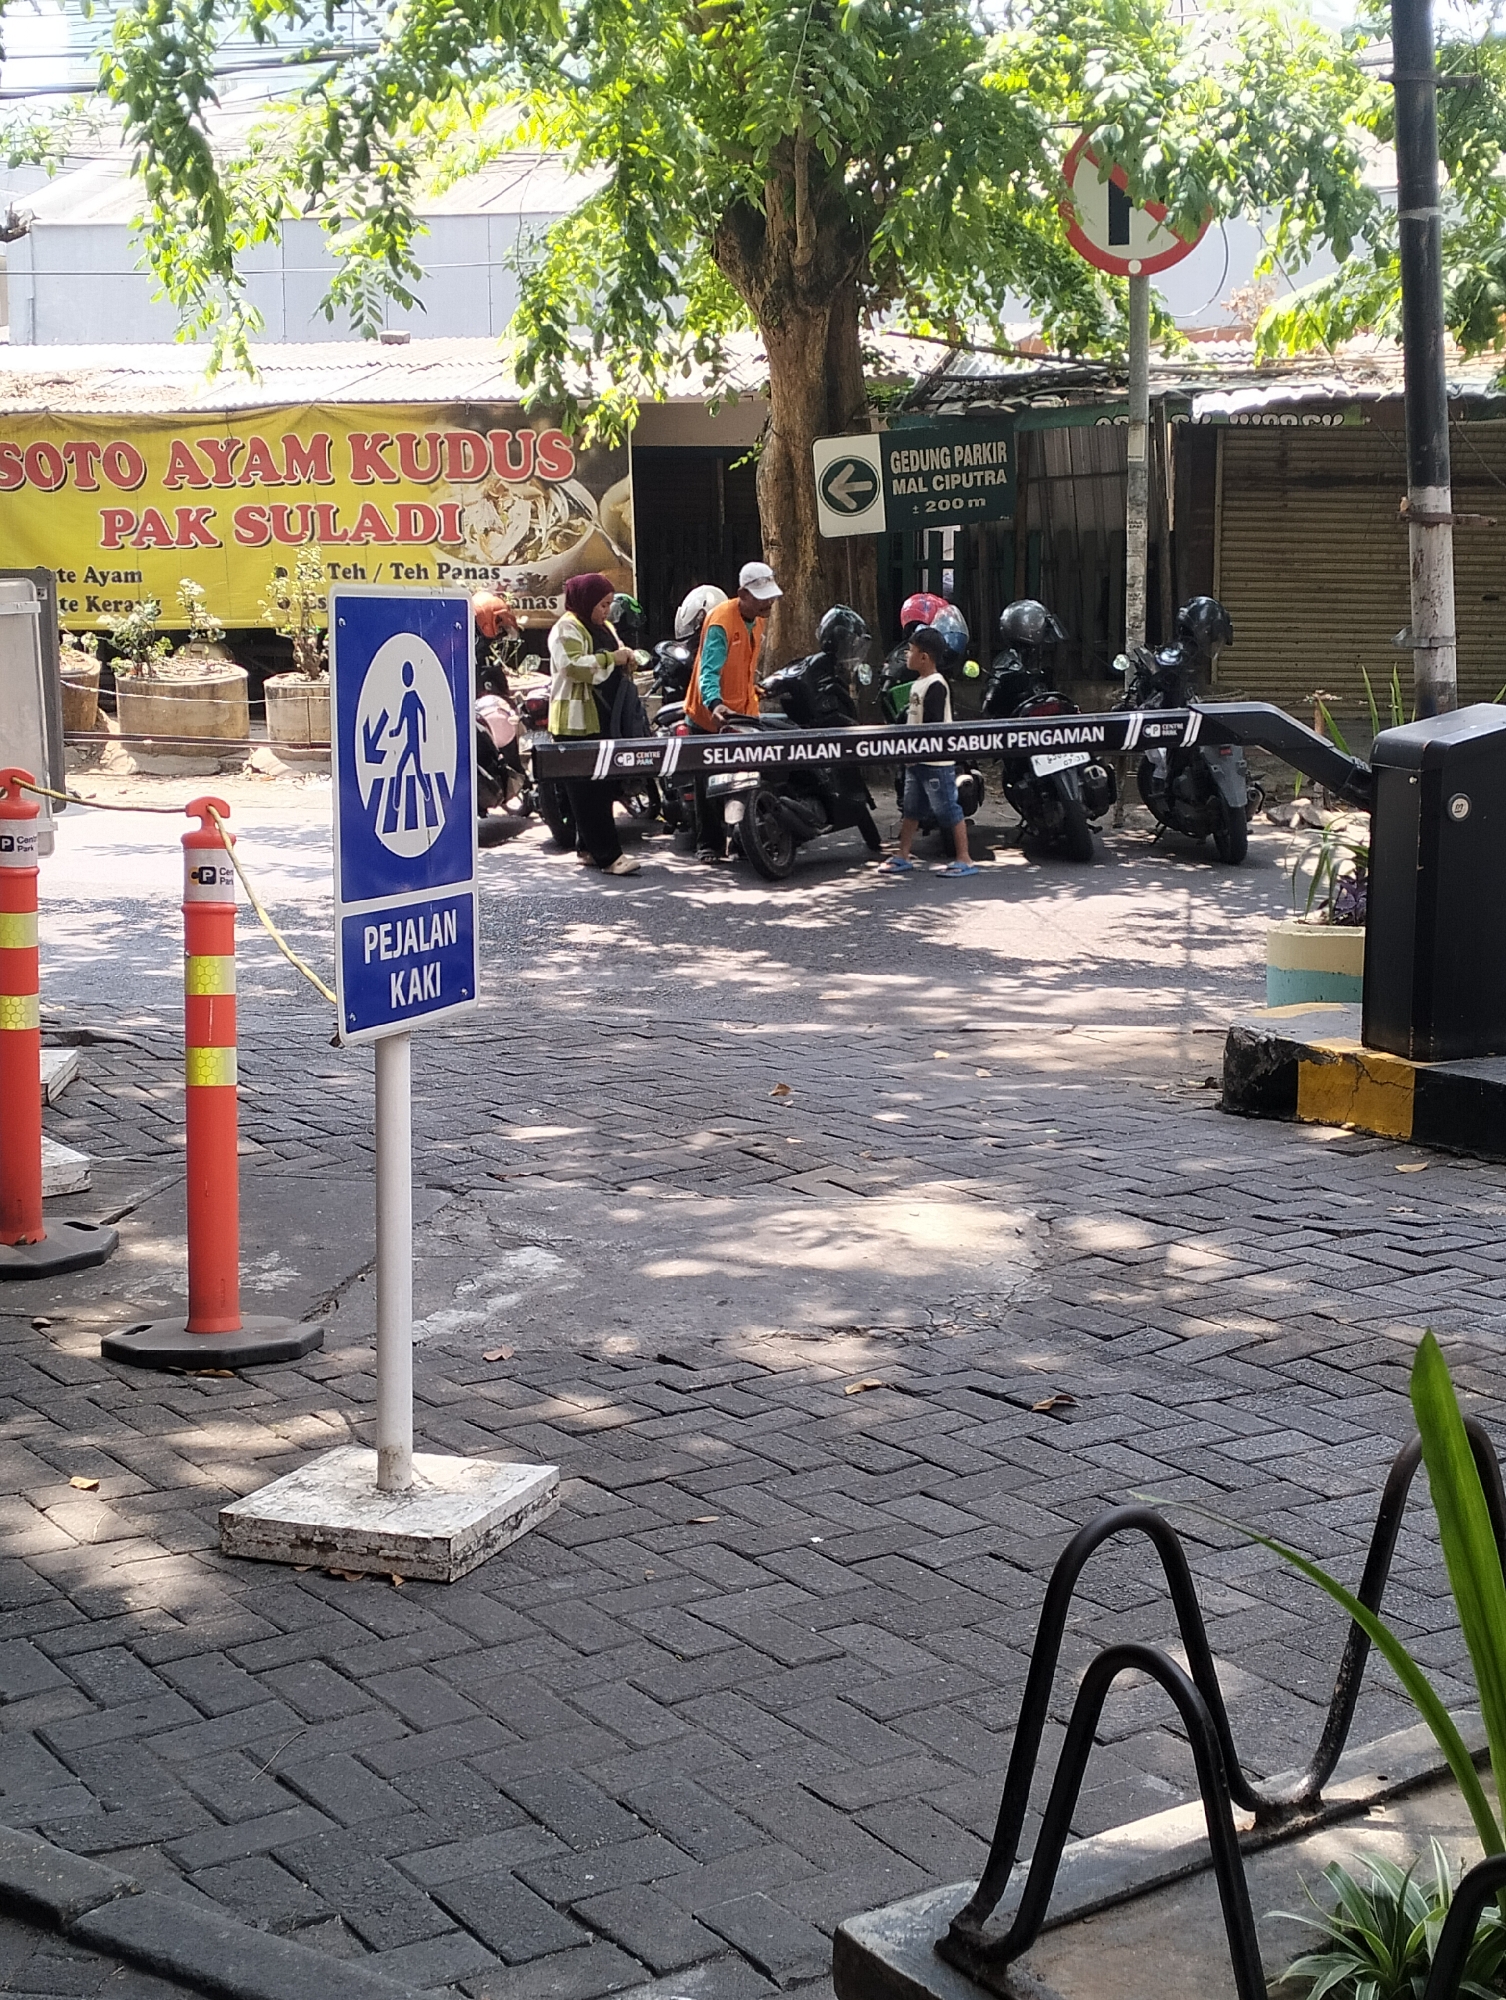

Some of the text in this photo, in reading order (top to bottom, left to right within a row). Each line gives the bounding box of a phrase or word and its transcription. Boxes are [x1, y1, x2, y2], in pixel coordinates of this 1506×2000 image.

[0, 429, 577, 493] SOTO AYAM KUDUS
[890, 441, 1007, 474] GEDUNG PARKIR
[892, 469, 1007, 495] MAL CIPUTRA
[925, 498, 964, 513] 200
[967, 497, 986, 508] m
[100, 502, 465, 549] PAK SULADI
[83, 566, 142, 587] Ayam
[327, 562, 366, 580] Teh
[372, 563, 383, 583] /
[390, 562, 430, 580] Teh
[437, 562, 500, 580] Panas
[503, 594, 558, 610] anas
[702, 745, 784, 765] SELAMAT
[787, 743, 841, 760] JALAN
[856, 737, 943, 757] GUNAKAN
[947, 733, 1004, 752] SABUK
[1007, 726, 1105, 748] PENGAMAN
[364, 908, 457, 965] PEJALAN
[390, 961, 441, 1009] KAKI
